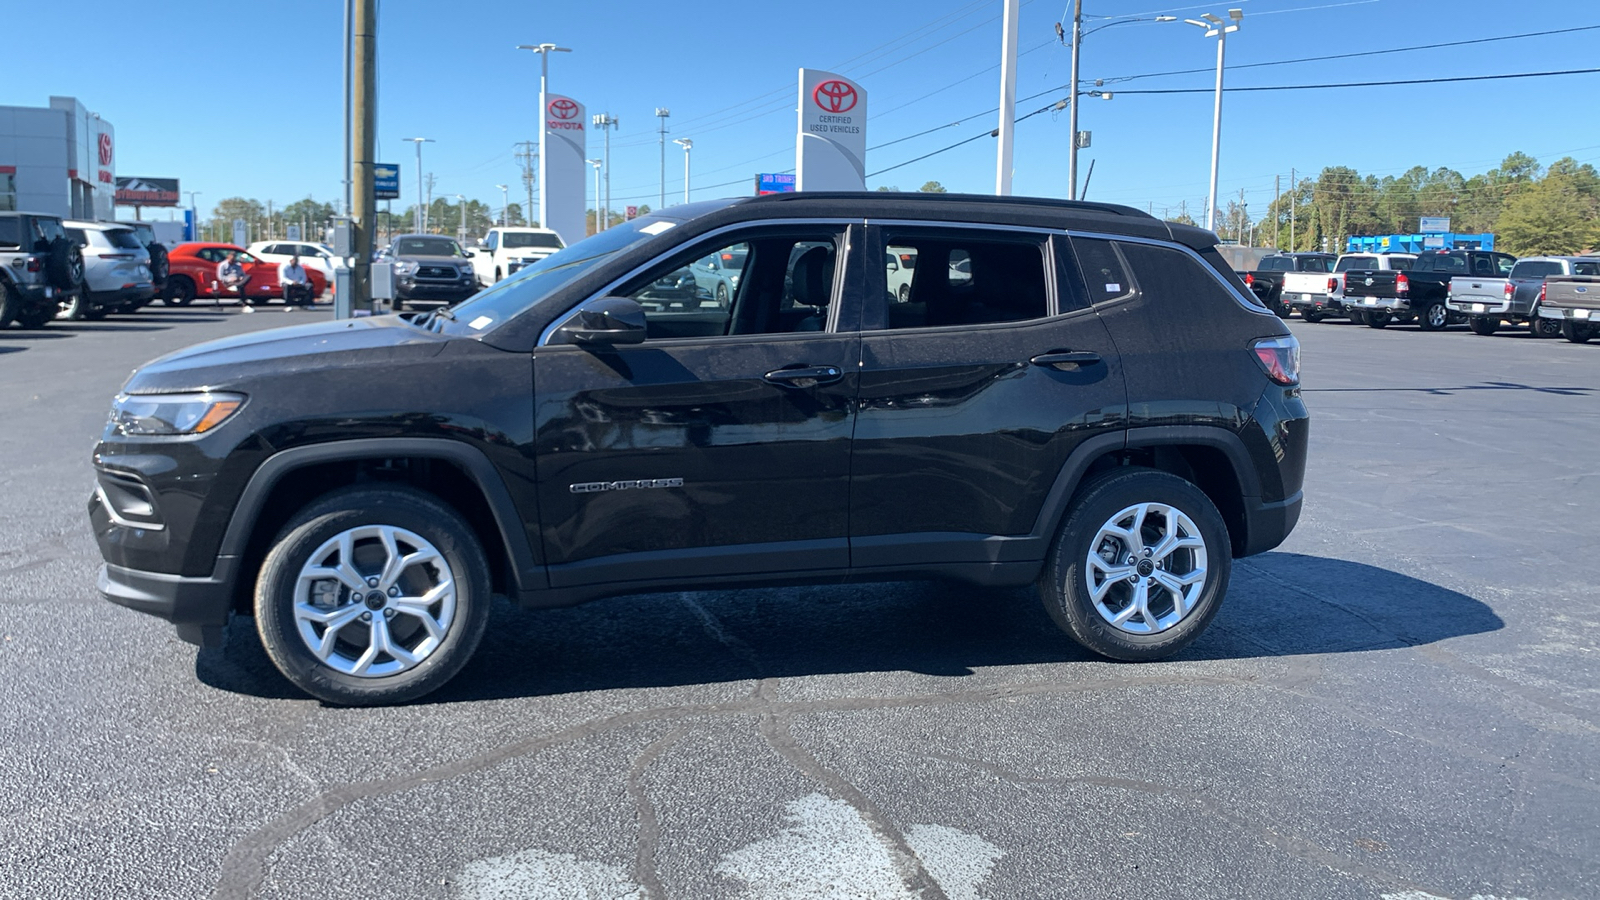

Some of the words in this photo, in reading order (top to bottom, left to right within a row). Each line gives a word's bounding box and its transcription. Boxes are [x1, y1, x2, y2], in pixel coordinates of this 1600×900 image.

[547, 117, 584, 131] TOYOTA
[819, 115, 852, 124] CERTIFIED
[810, 124, 828, 132] USED
[829, 125, 860, 134] VEHICLES
[570, 478, 683, 493] COMPASS
